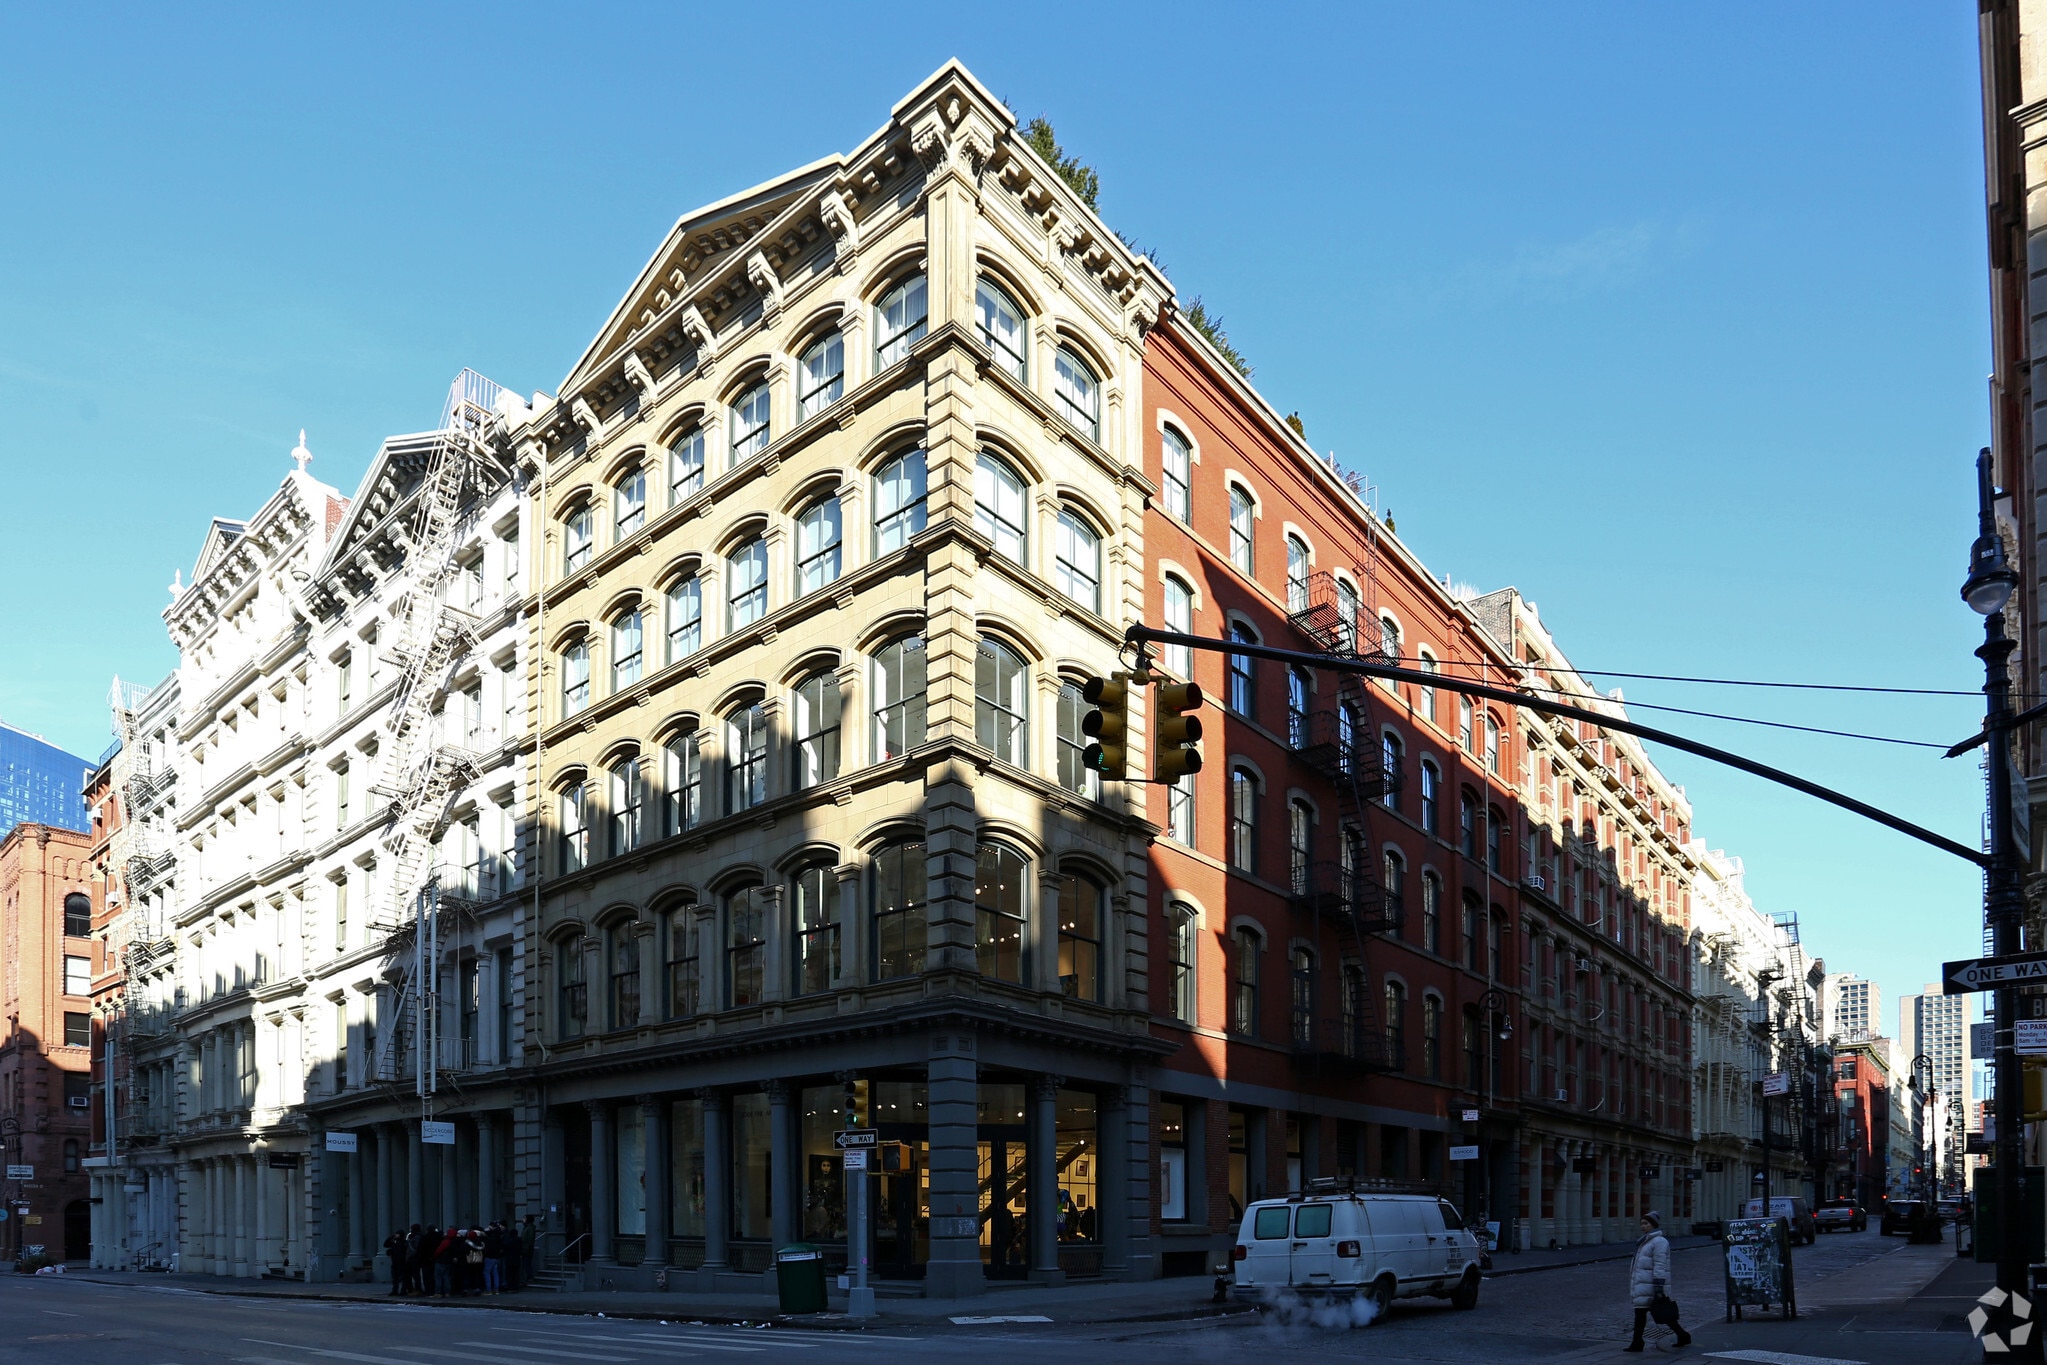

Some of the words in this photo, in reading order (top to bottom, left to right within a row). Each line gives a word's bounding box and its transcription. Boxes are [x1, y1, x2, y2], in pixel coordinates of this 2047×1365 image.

[1967, 967, 2003, 982] ONE
[2018, 1023, 2028, 1031] NO
[977, 1102, 990, 1111] RT
[840, 1136, 853, 1144] ONE
[858, 1135, 872, 1143] WAY
